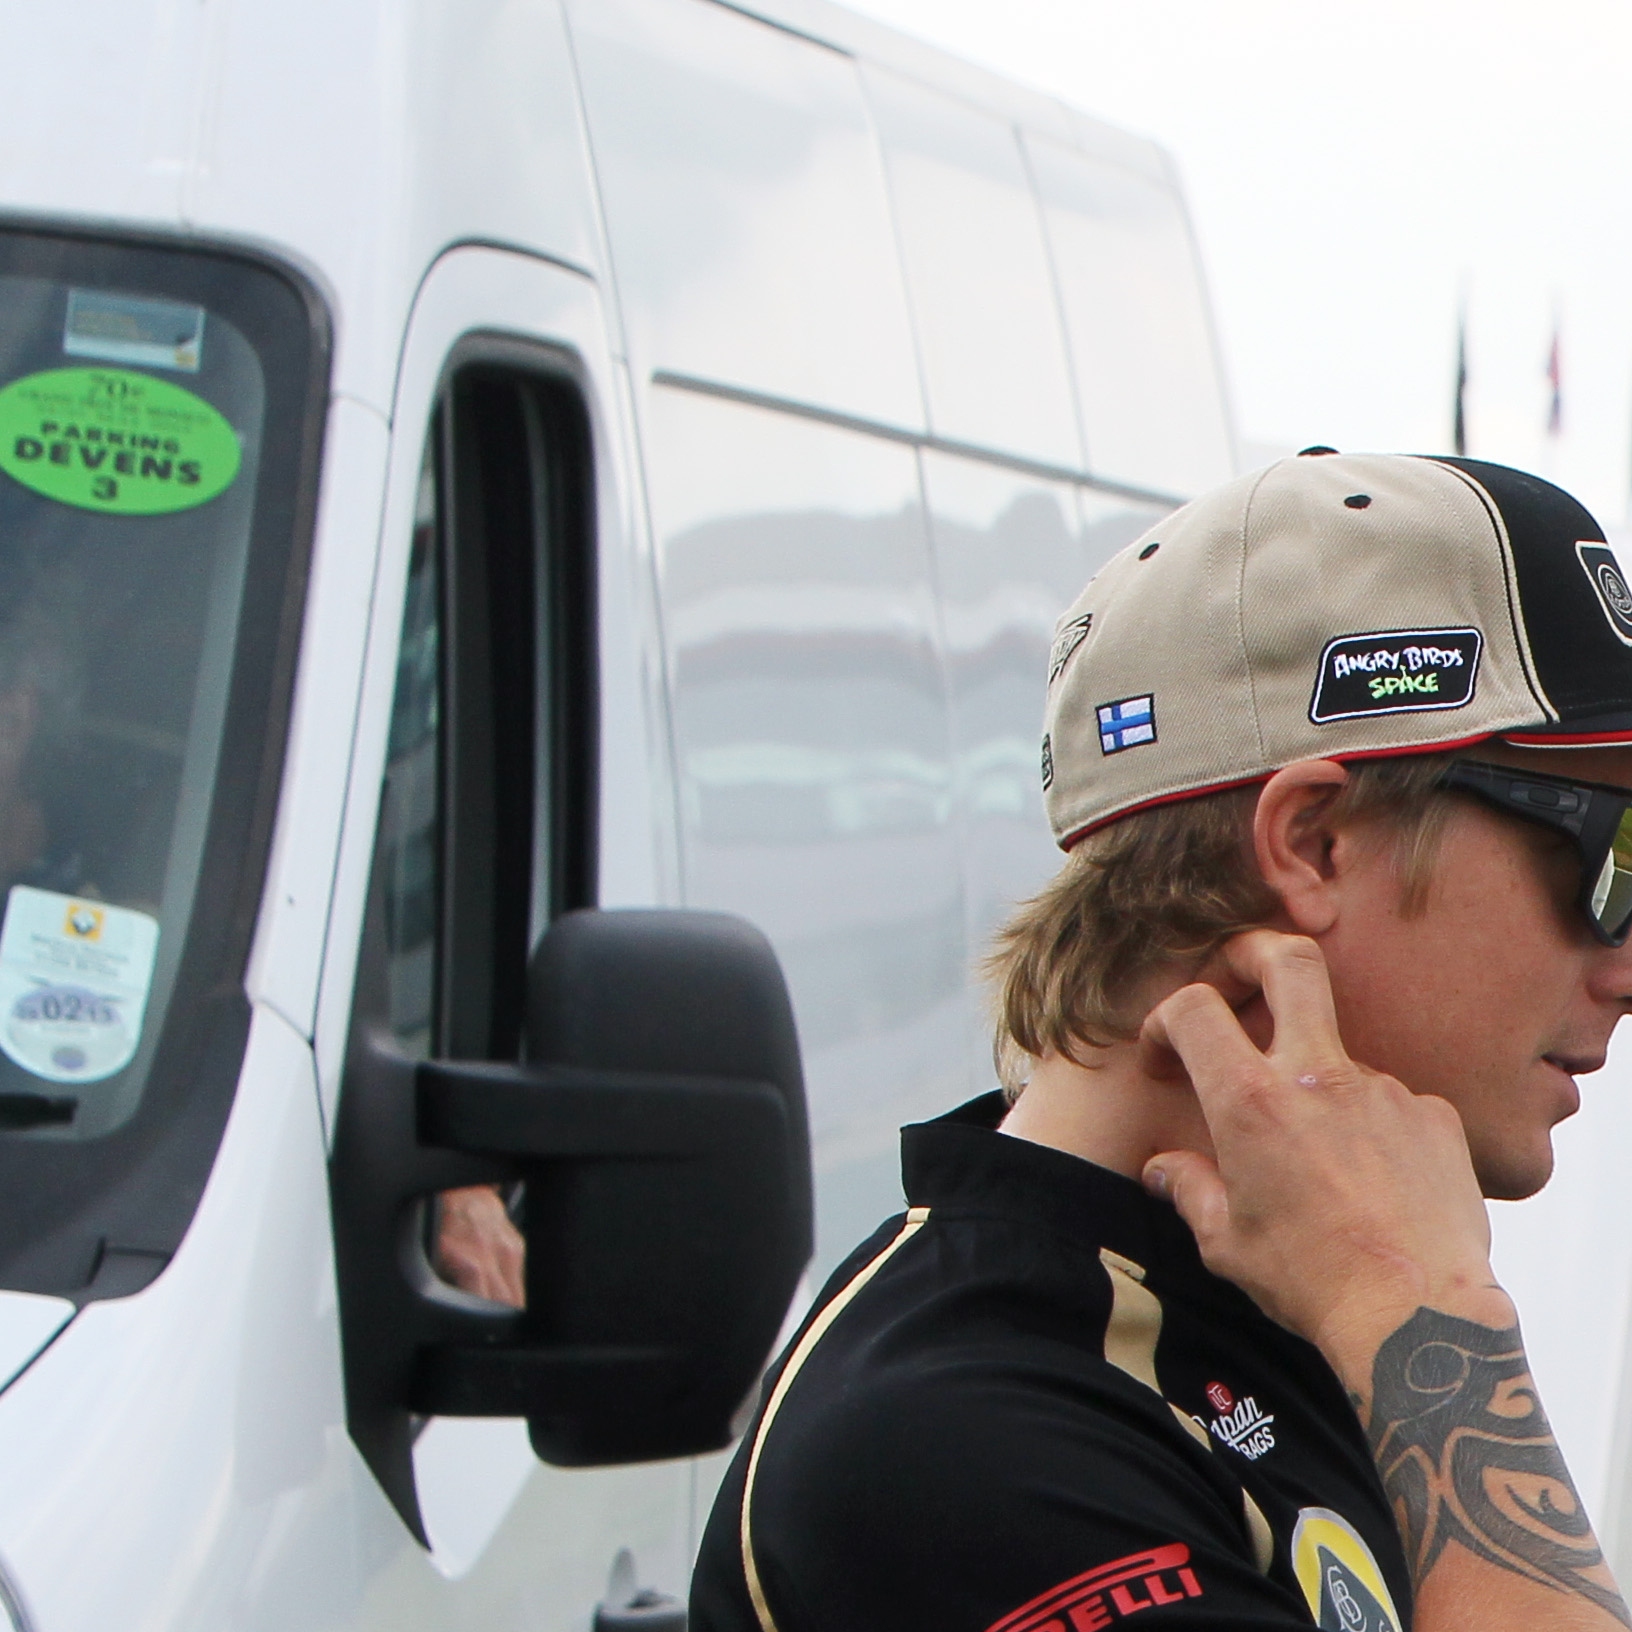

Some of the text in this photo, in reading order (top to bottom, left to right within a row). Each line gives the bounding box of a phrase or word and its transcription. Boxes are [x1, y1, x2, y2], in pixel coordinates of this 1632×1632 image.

[41, 421, 179, 454] PARKING
[15, 434, 201, 485] DEVENS
[1334, 646, 1464, 679] ANGRY BIRDS
[1368, 666, 1439, 699] SPACE
